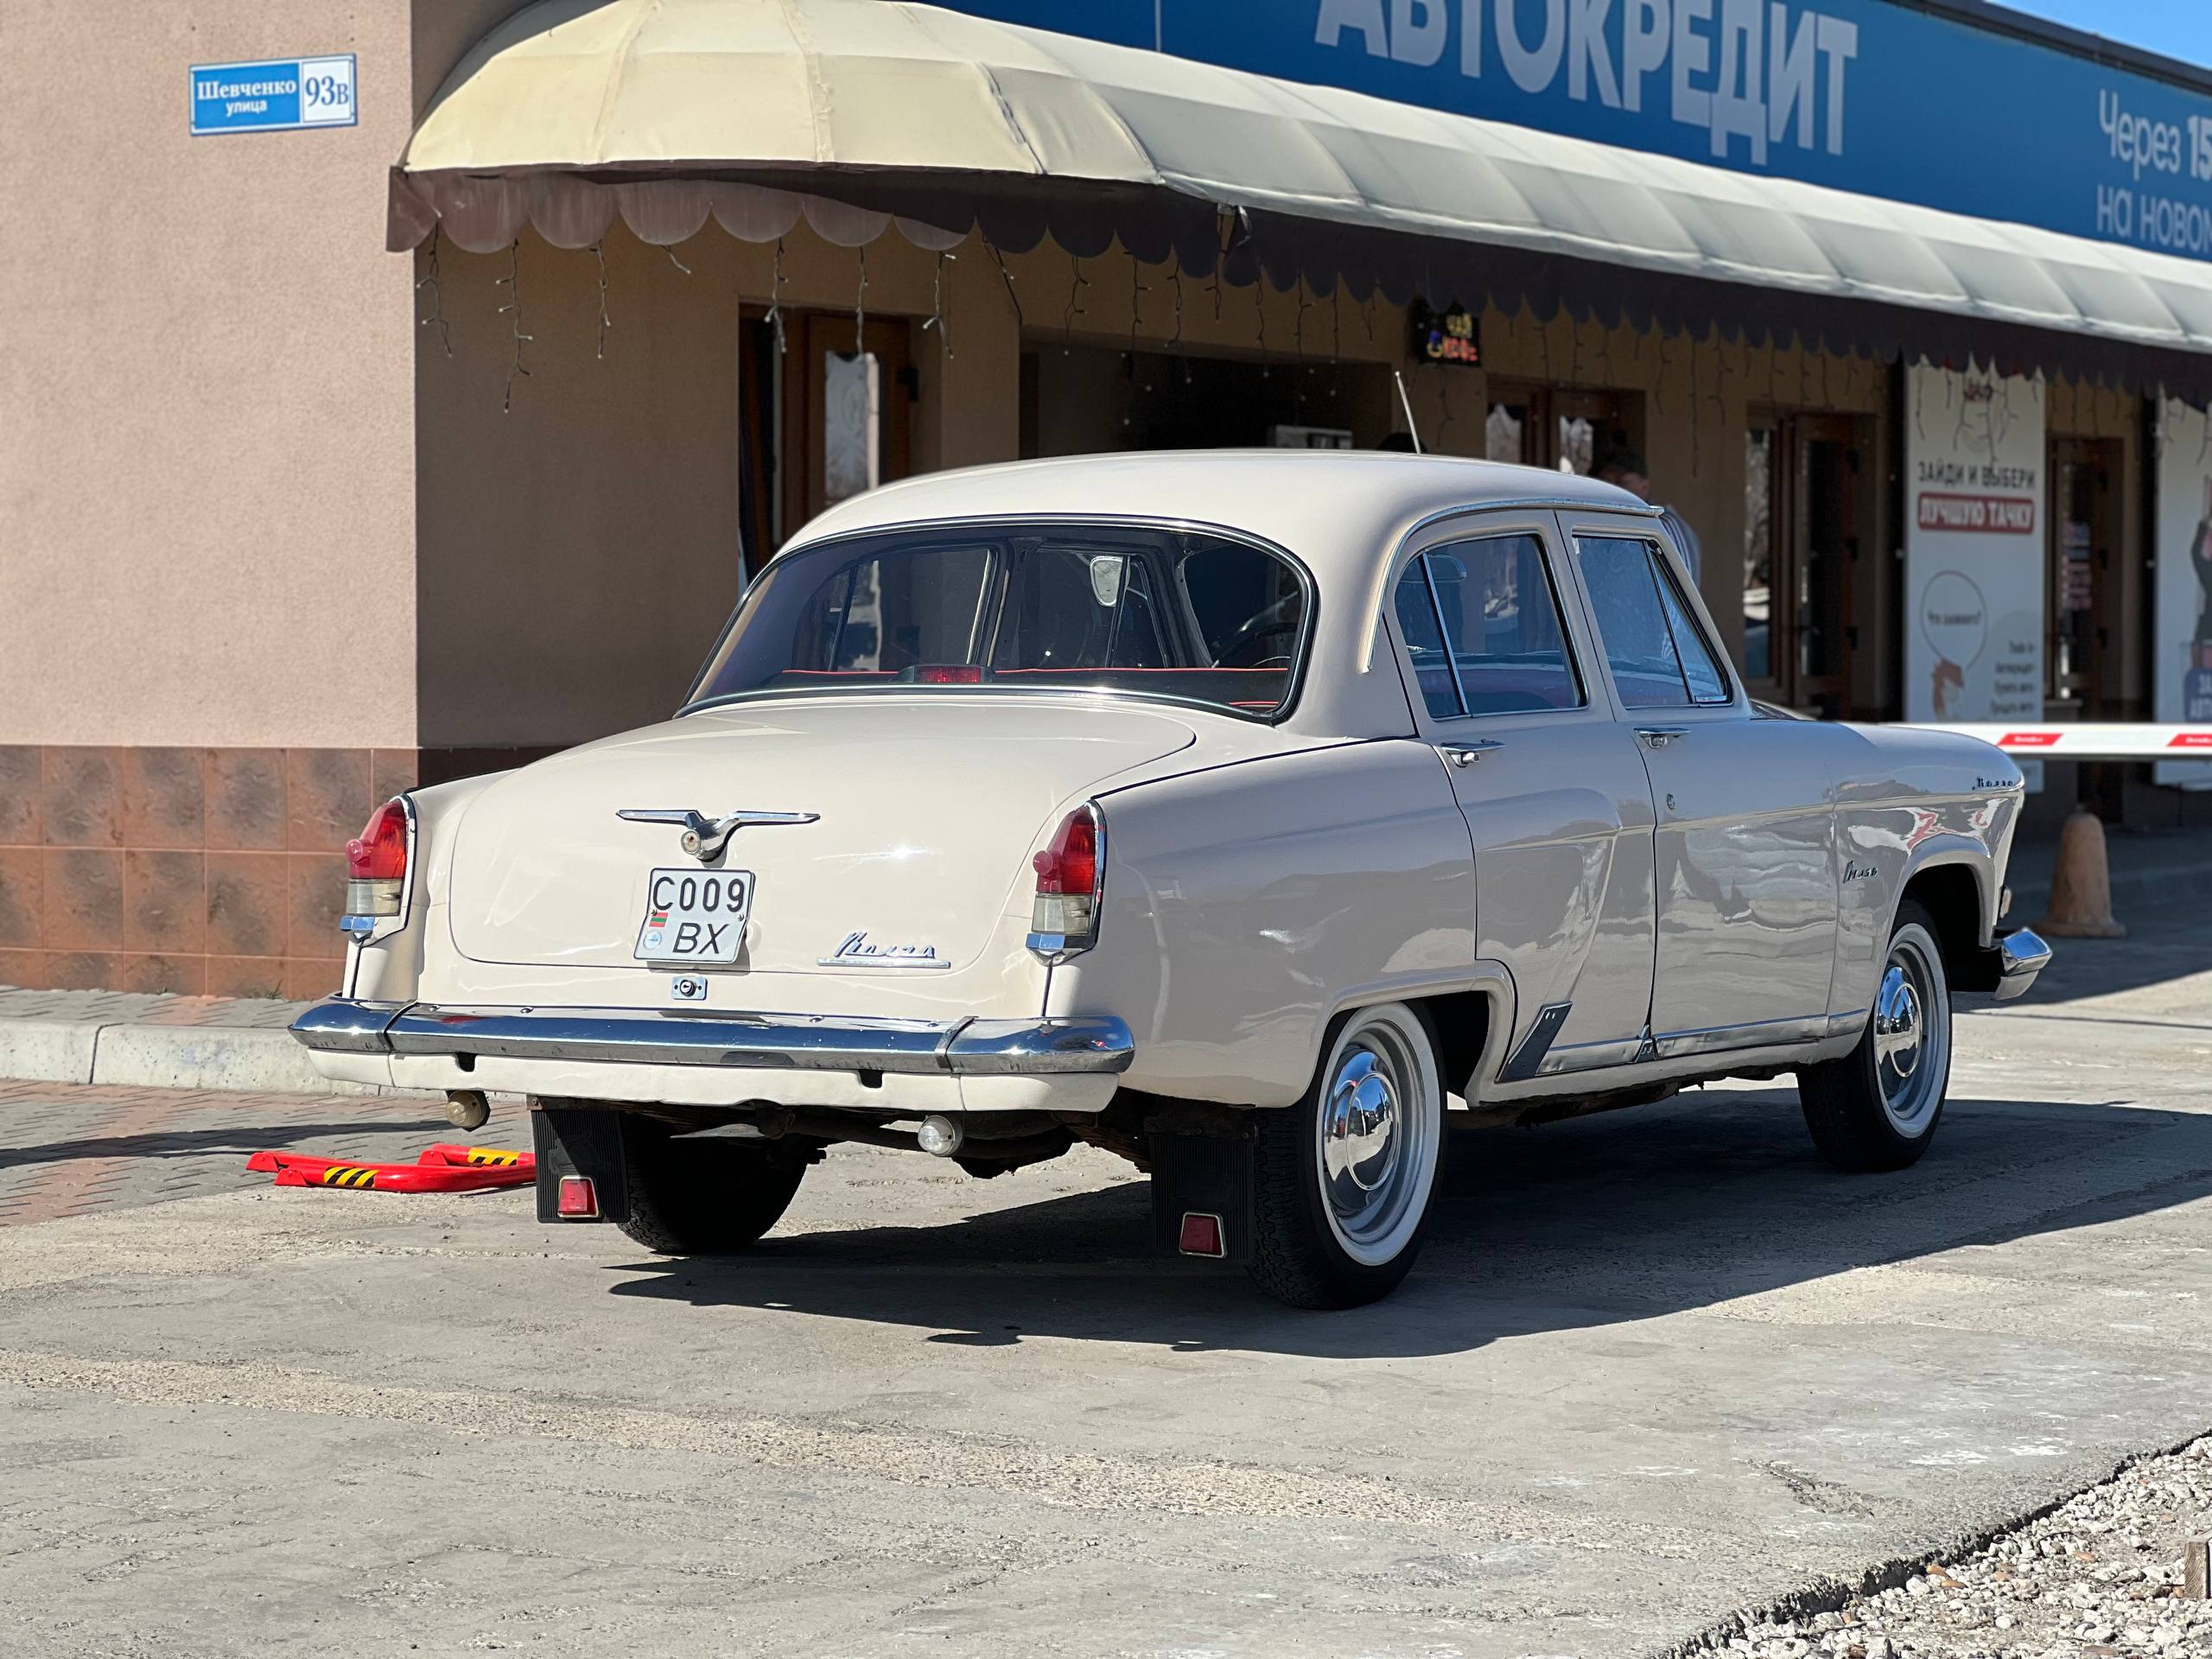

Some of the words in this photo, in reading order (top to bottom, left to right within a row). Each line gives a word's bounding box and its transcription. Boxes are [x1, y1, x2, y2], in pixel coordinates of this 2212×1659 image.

[197, 79, 297, 100] Шевченко
[226, 99, 268, 117] улица
[2099, 88, 2181, 181] Через
[1918, 458, 1964, 487] ЗАЙДИ
[1968, 464, 1978, 485] И
[652, 876, 746, 912] C009
[672, 921, 729, 955] BX
